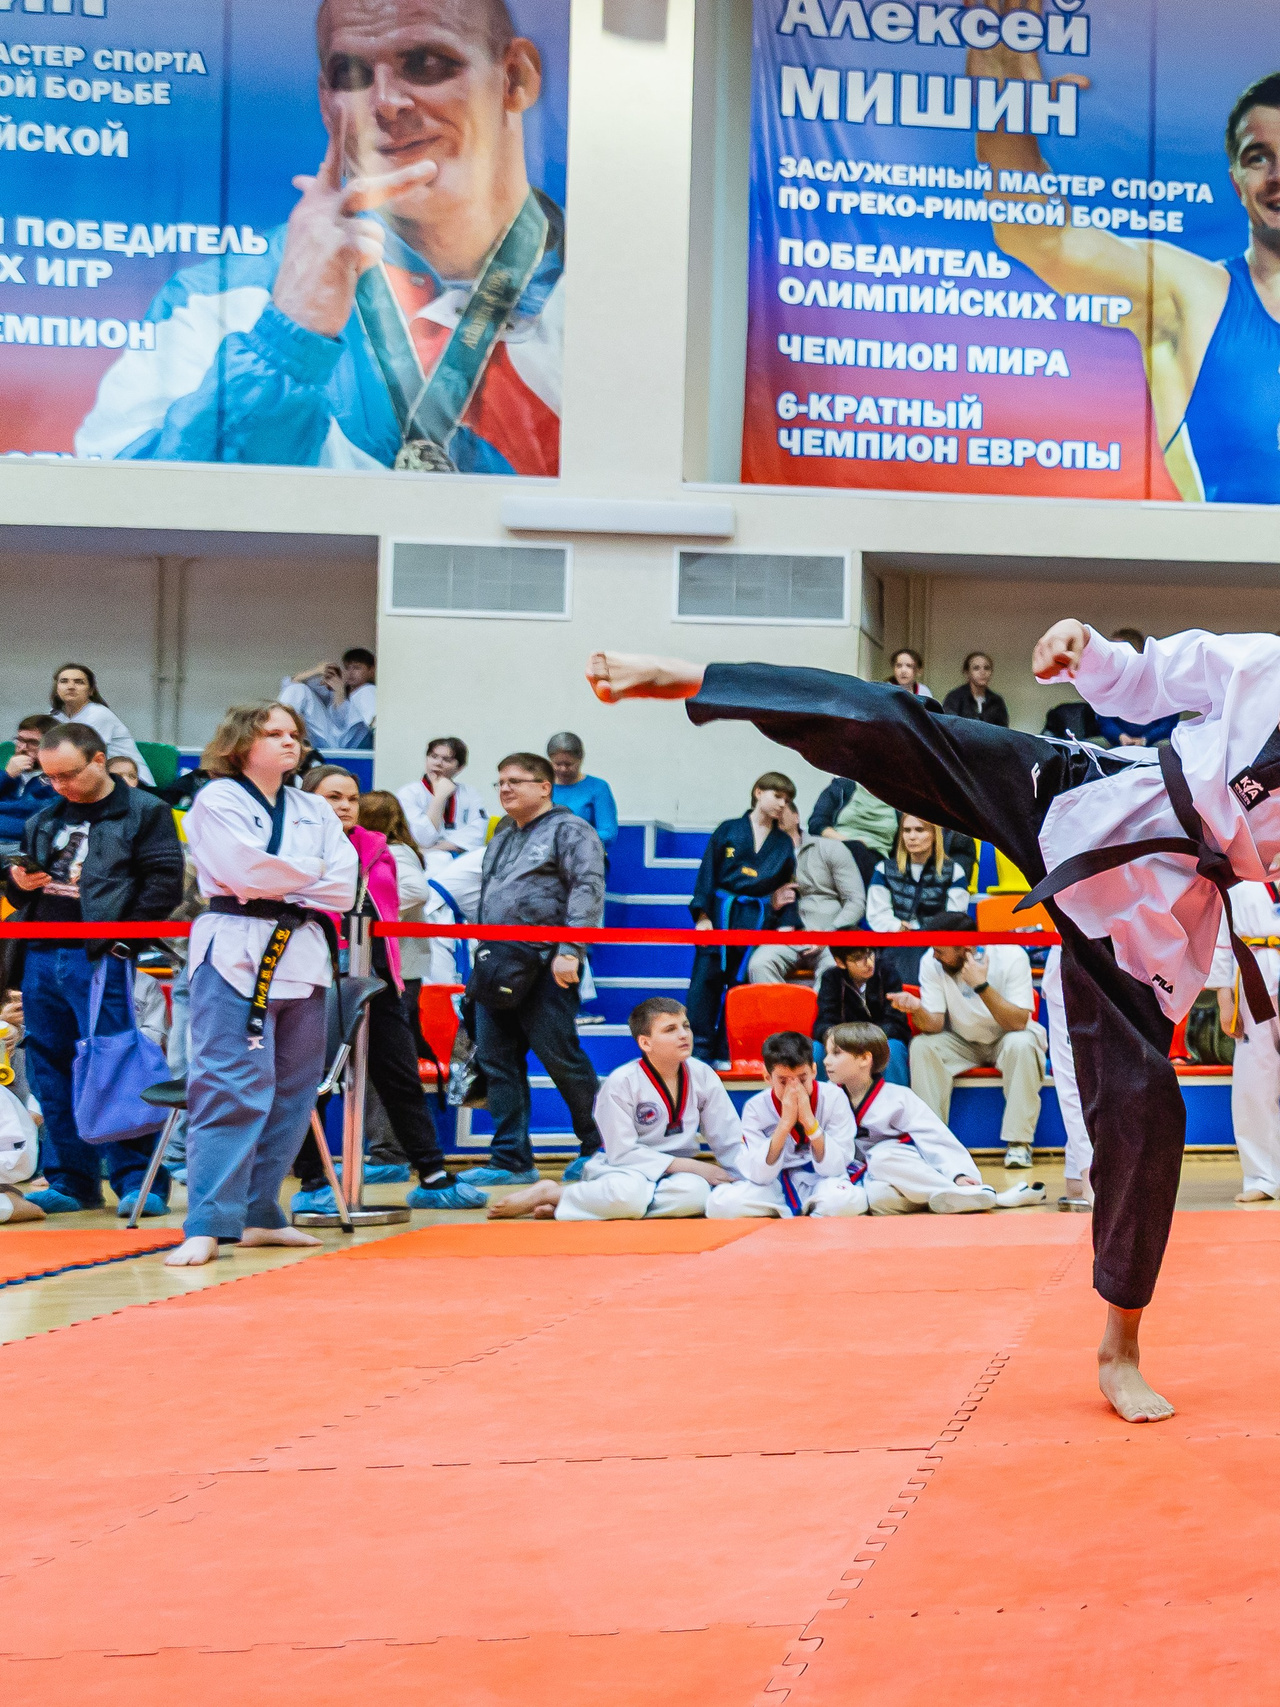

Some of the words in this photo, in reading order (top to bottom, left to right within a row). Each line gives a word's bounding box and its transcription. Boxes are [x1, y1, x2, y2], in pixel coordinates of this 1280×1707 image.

[780, 0, 1088, 54] Алексей
[93, 50, 206, 75] СПОРТА
[45, 77, 171, 105] БОРЬБЕ
[781, 65, 1077, 136] МИШИН
[779, 155, 992, 191] ЗАСЛУЖЕННЫЙ
[1000, 170, 1105, 197] МАСТЕР
[1111, 178, 1214, 204] СПОРТА
[779, 185, 820, 211] ПО
[827, 190, 1065, 226] ГРЕКО-РИМСКОЙ
[1071, 205, 1184, 233] БОРЬБЕ
[16, 217, 268, 258] ПОБЕДИТЕЛЬ
[779, 237, 1011, 280] ПОБЕДИТЕЛЬ
[37, 257, 113, 288] ИГР
[778, 277, 1057, 321] ОЛИМПИЙСКИХ
[1065, 293, 1132, 324] ИГР
[0, 313, 155, 349] МПИОН
[778, 334, 957, 372] ЧЕМПИОН
[966, 345, 1070, 377] МИРА
[777, 391, 983, 430] 6-КРАТНЫЙ
[778, 428, 958, 465] ЧЕМПИОН
[966, 437, 1121, 471] ЕВРОПЫ
[1151, 973, 1174, 994] FILA
